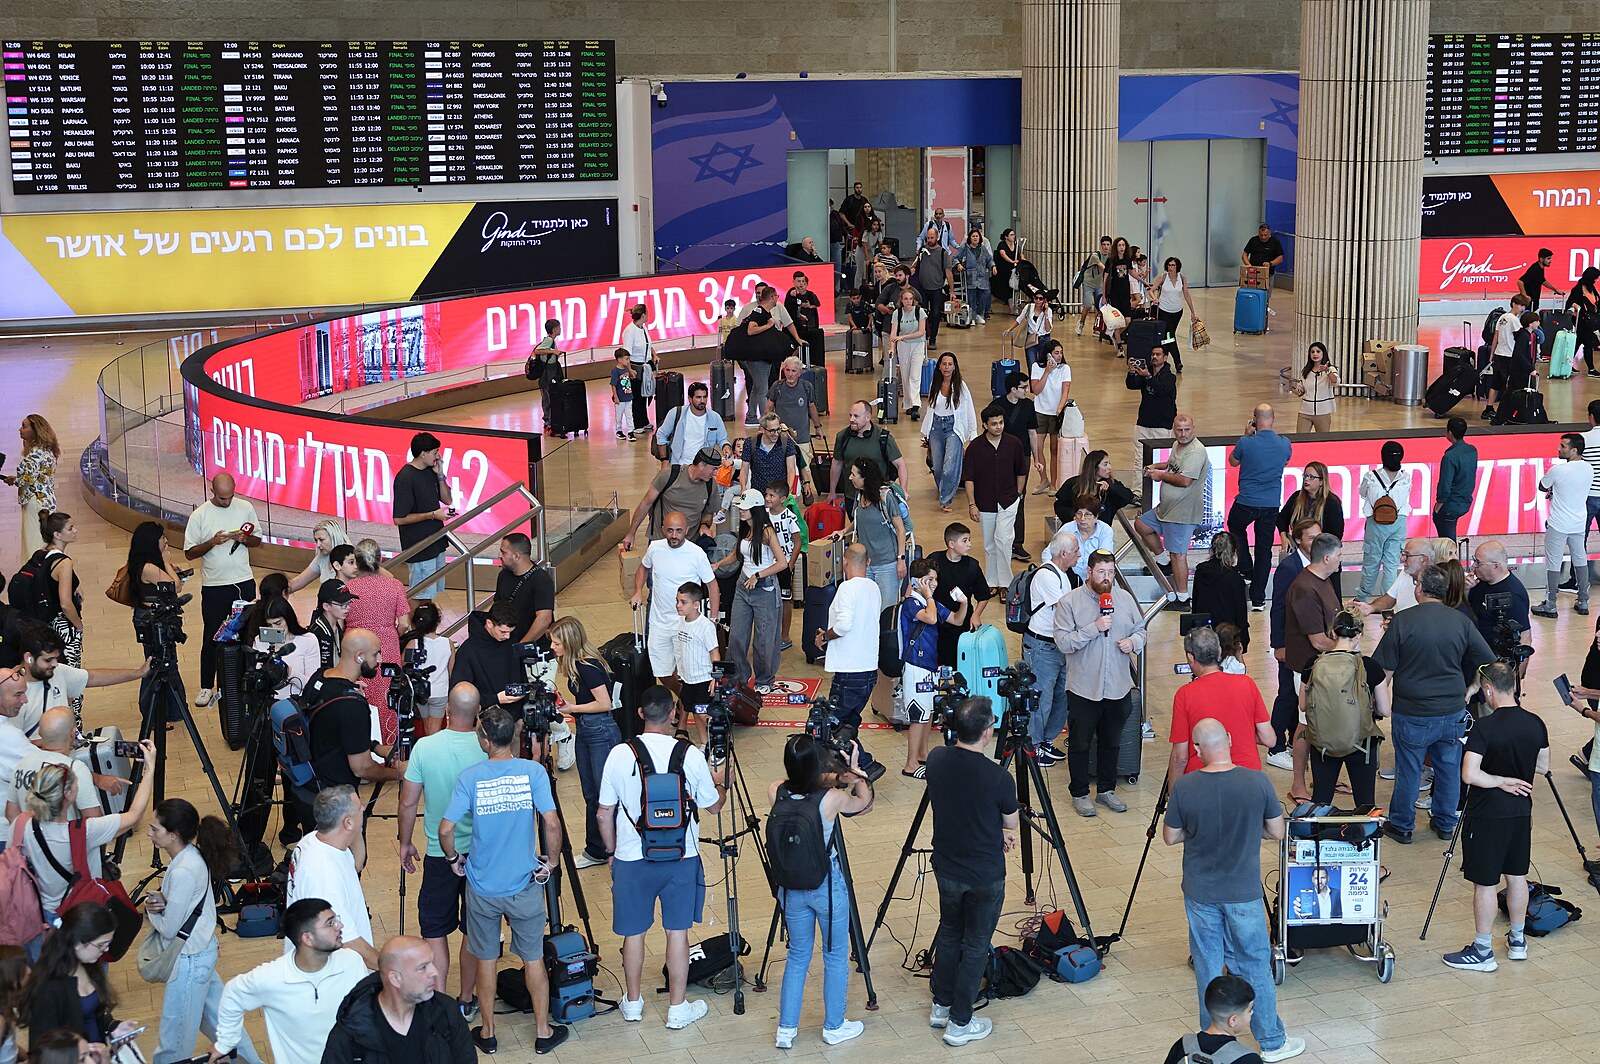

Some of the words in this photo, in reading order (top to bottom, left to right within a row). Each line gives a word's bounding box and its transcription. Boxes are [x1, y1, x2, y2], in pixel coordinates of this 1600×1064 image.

[1429, 191, 1456, 200] ולתמיד
[1458, 192, 1471, 201] כאן
[1532, 188, 1590, 208] המחר
[532, 218, 567, 228] ולתמיד
[571, 219, 588, 229] כאן
[46, 232, 126, 259] אושר
[134, 228, 180, 256] של
[190, 228, 273, 255] רגעים
[284, 222, 343, 252] לכם
[355, 223, 429, 249] בונים
[1462, 276, 1490, 284] החזקות
[486, 297, 587, 352] מגורים
[212, 416, 287, 486] מגורים
[298, 431, 390, 512] מגדלי
[476, 800, 533, 815] QUIKSILVER
[1349, 873, 1368, 885] 24
